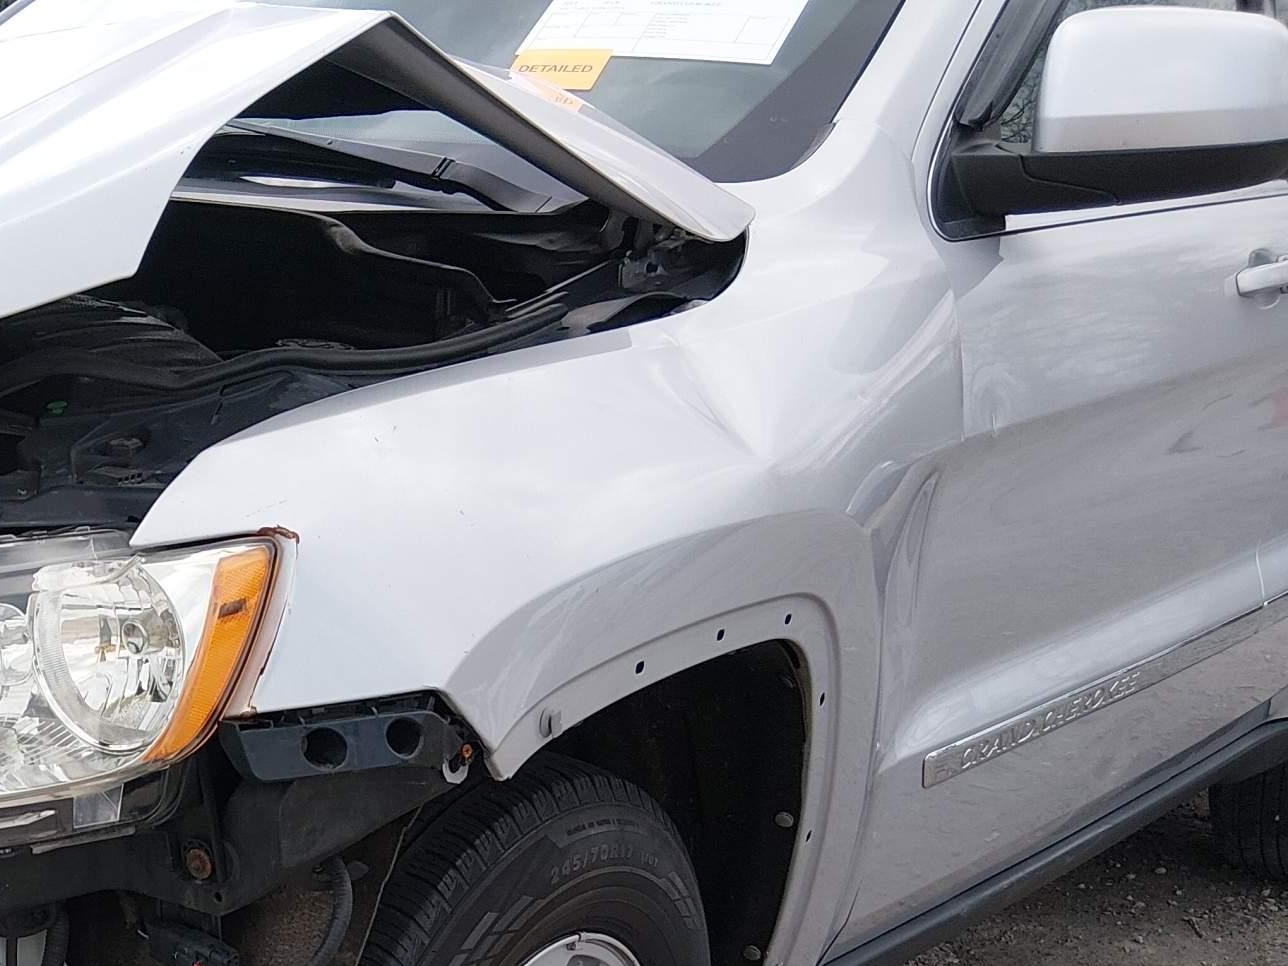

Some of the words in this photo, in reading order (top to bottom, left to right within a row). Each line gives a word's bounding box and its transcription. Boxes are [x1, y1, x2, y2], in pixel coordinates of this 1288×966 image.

[518, 64, 593, 73] DETAILED
[960, 718, 1037, 770] GRAND
[1041, 671, 1141, 732] CHEROKEE
